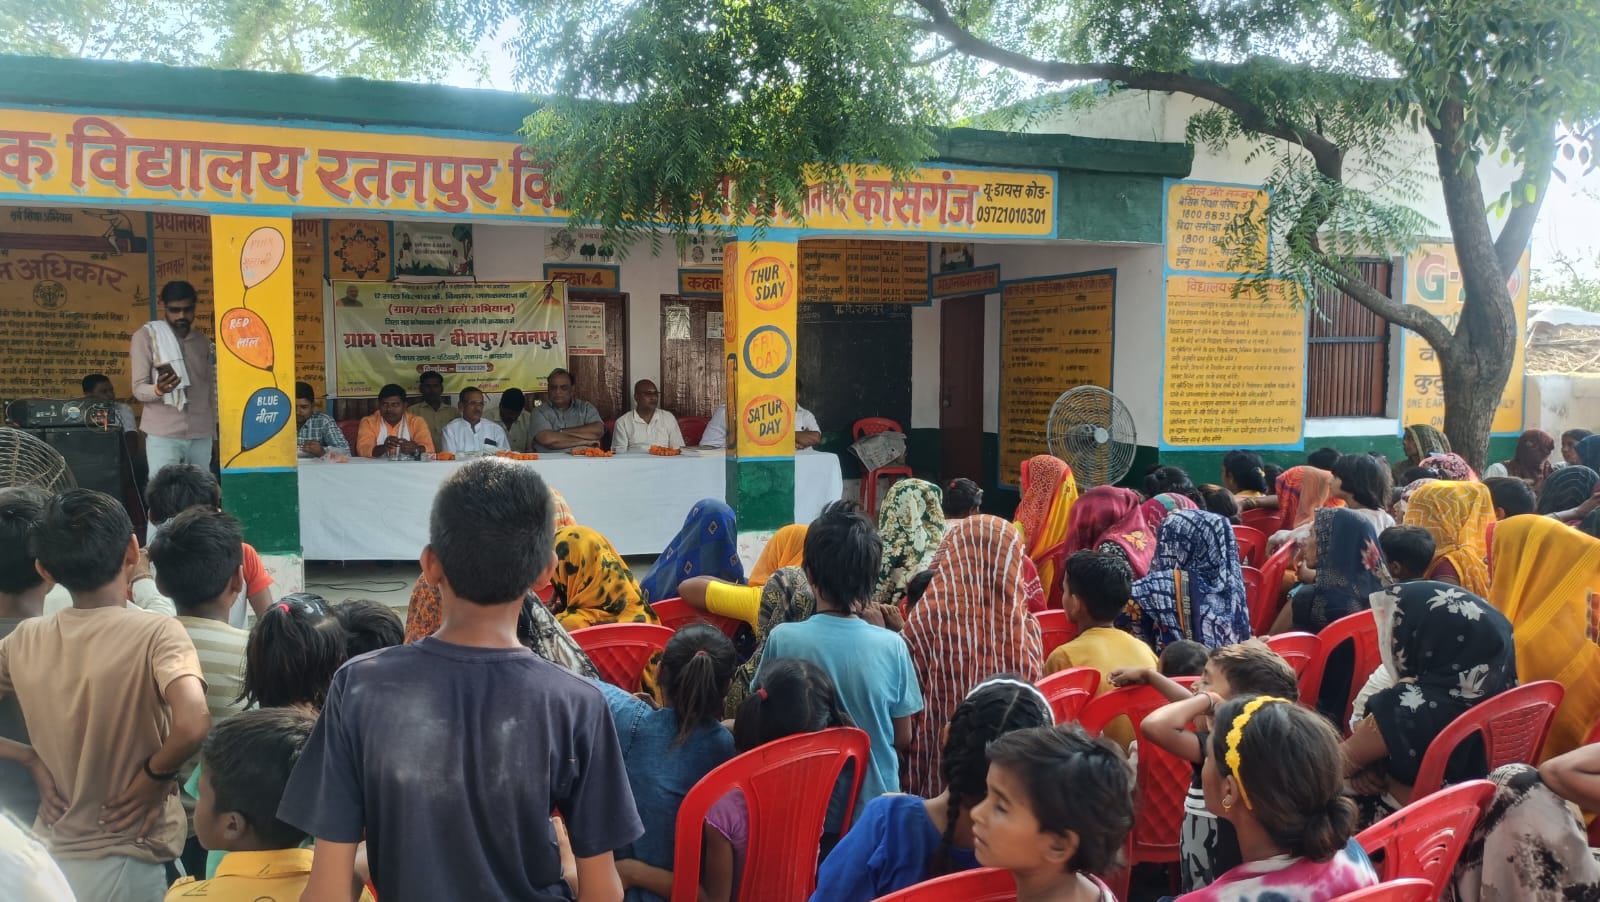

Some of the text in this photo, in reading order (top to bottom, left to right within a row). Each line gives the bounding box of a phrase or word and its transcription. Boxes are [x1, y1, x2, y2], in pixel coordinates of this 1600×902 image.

[66, 117, 308, 198] विद्यालय
[316, 148, 500, 214] रतनपुर
[853, 171, 981, 226] कासगंज
[976, 206, 1046, 225] 09721010301
[1182, 209, 1202, 219] 1800
[1181, 234, 1205, 244] 1800
[16, 253, 128, 292] अधिकार
[751, 264, 779, 284] THUR
[755, 281, 786, 301] SDAY
[229, 318, 249, 330] RED
[236, 336, 260, 349] लाल
[343, 332, 377, 349] ग्राम
[380, 329, 436, 347] पंचायत
[755, 350, 781, 371] DAY
[257, 395, 279, 407] BLUE
[255, 408, 279, 424] नीला
[748, 399, 783, 424] SATUR
[759, 419, 782, 437] DAY
